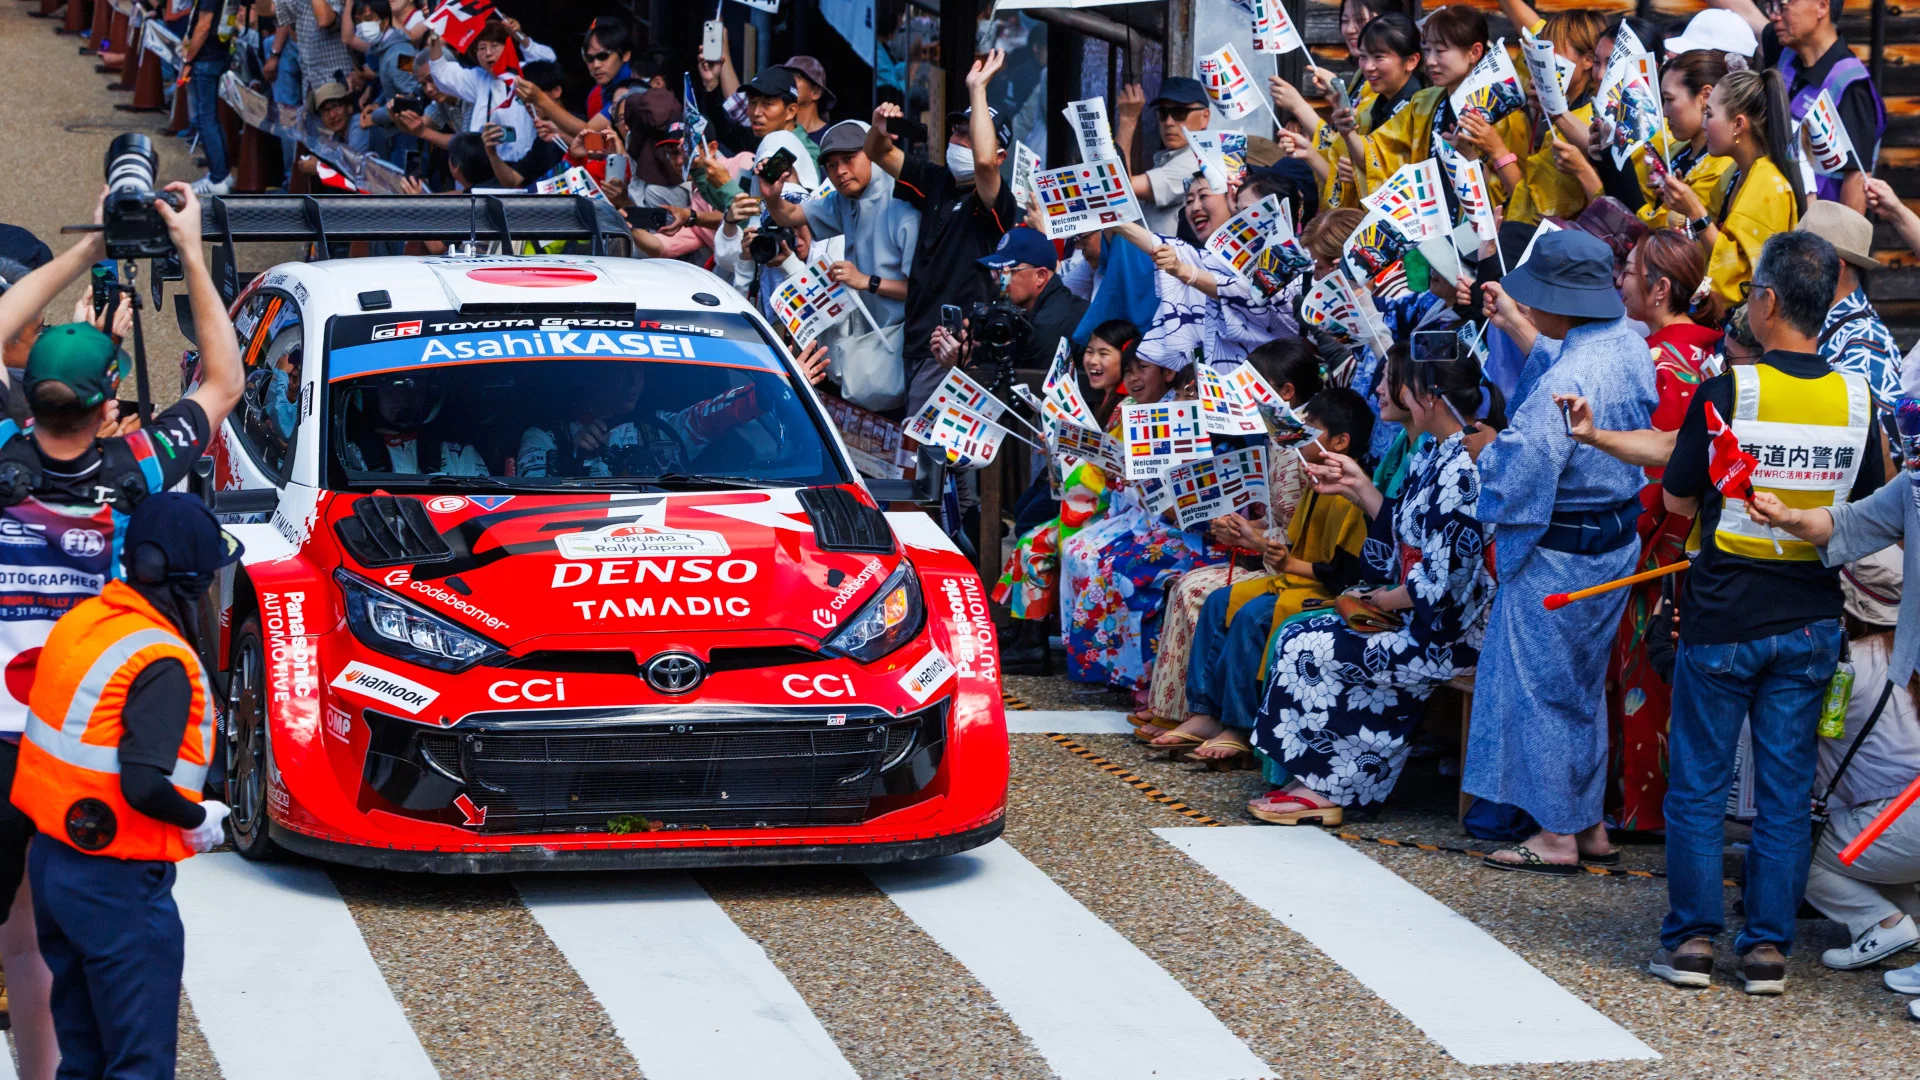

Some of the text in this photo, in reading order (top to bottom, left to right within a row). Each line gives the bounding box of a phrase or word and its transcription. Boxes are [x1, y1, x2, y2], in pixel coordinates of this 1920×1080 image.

[1076, 104, 1088, 112] WRC
[1079, 111, 1100, 121] FORUM8
[1081, 121, 1095, 129] RALLY
[1083, 130, 1098, 138] JAPAN
[1051, 215, 1080, 227] Welcome
[1065, 224, 1077, 233] City
[375, 318, 724, 339] GR TOYOTA GAZOO Racing
[421, 332, 695, 362] AsahiKASEI
[1205, 414, 1225, 422] Welcome
[1058, 444, 1088, 455] Welcome
[1133, 459, 1164, 467] Welcome
[1133, 467, 1158, 475] Ena City
[1181, 501, 1220, 518] Welcome to
[1182, 511, 1208, 524] Ena City
[272, 510, 298, 543] TAMADIC
[64, 532, 101, 553] FIA
[551, 559, 757, 588] DENSO
[830, 559, 880, 610] codebeamer
[16, 607, 27, 616] 31
[30, 607, 48, 615] MAY
[410, 579, 507, 631] codebeamer
[573, 597, 750, 620] TAMADIC
[940, 578, 976, 678] Panasonic
[969, 577, 996, 682] AUTOMOTIVE
[263, 592, 290, 702] AUTOMOTIVE
[284, 591, 311, 697] Panasonic
[326, 709, 351, 737] OMP
[829, 715, 845, 724] GR
